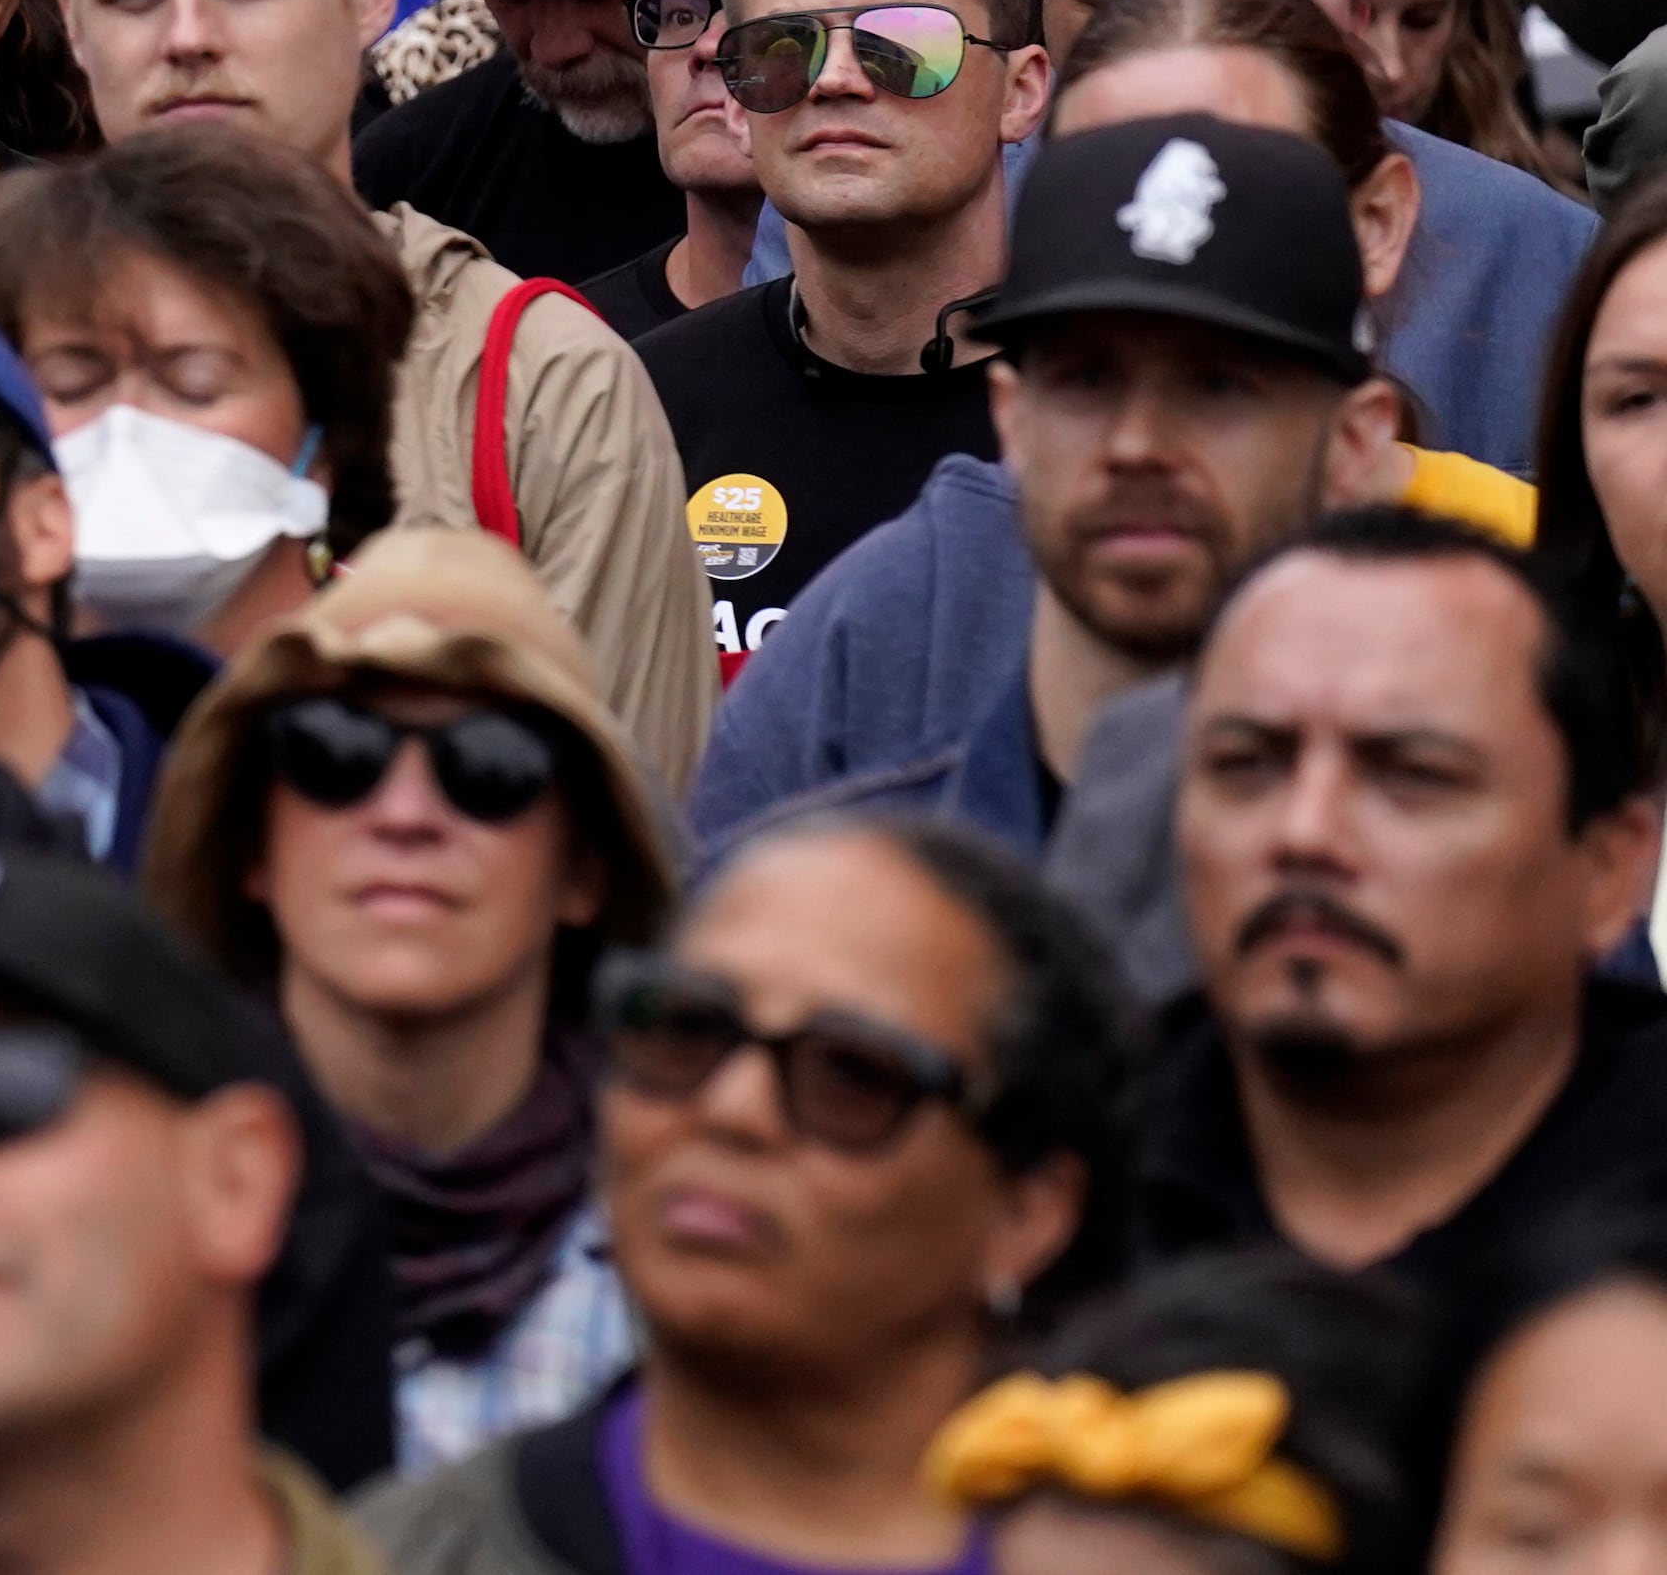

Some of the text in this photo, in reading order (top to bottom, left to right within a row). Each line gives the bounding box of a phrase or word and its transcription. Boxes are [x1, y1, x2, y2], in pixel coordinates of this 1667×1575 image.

[712, 487, 763, 511] $25
[707, 511, 763, 525] HEALTHCARE
[698, 523, 767, 538] MINIMUM WAGE
